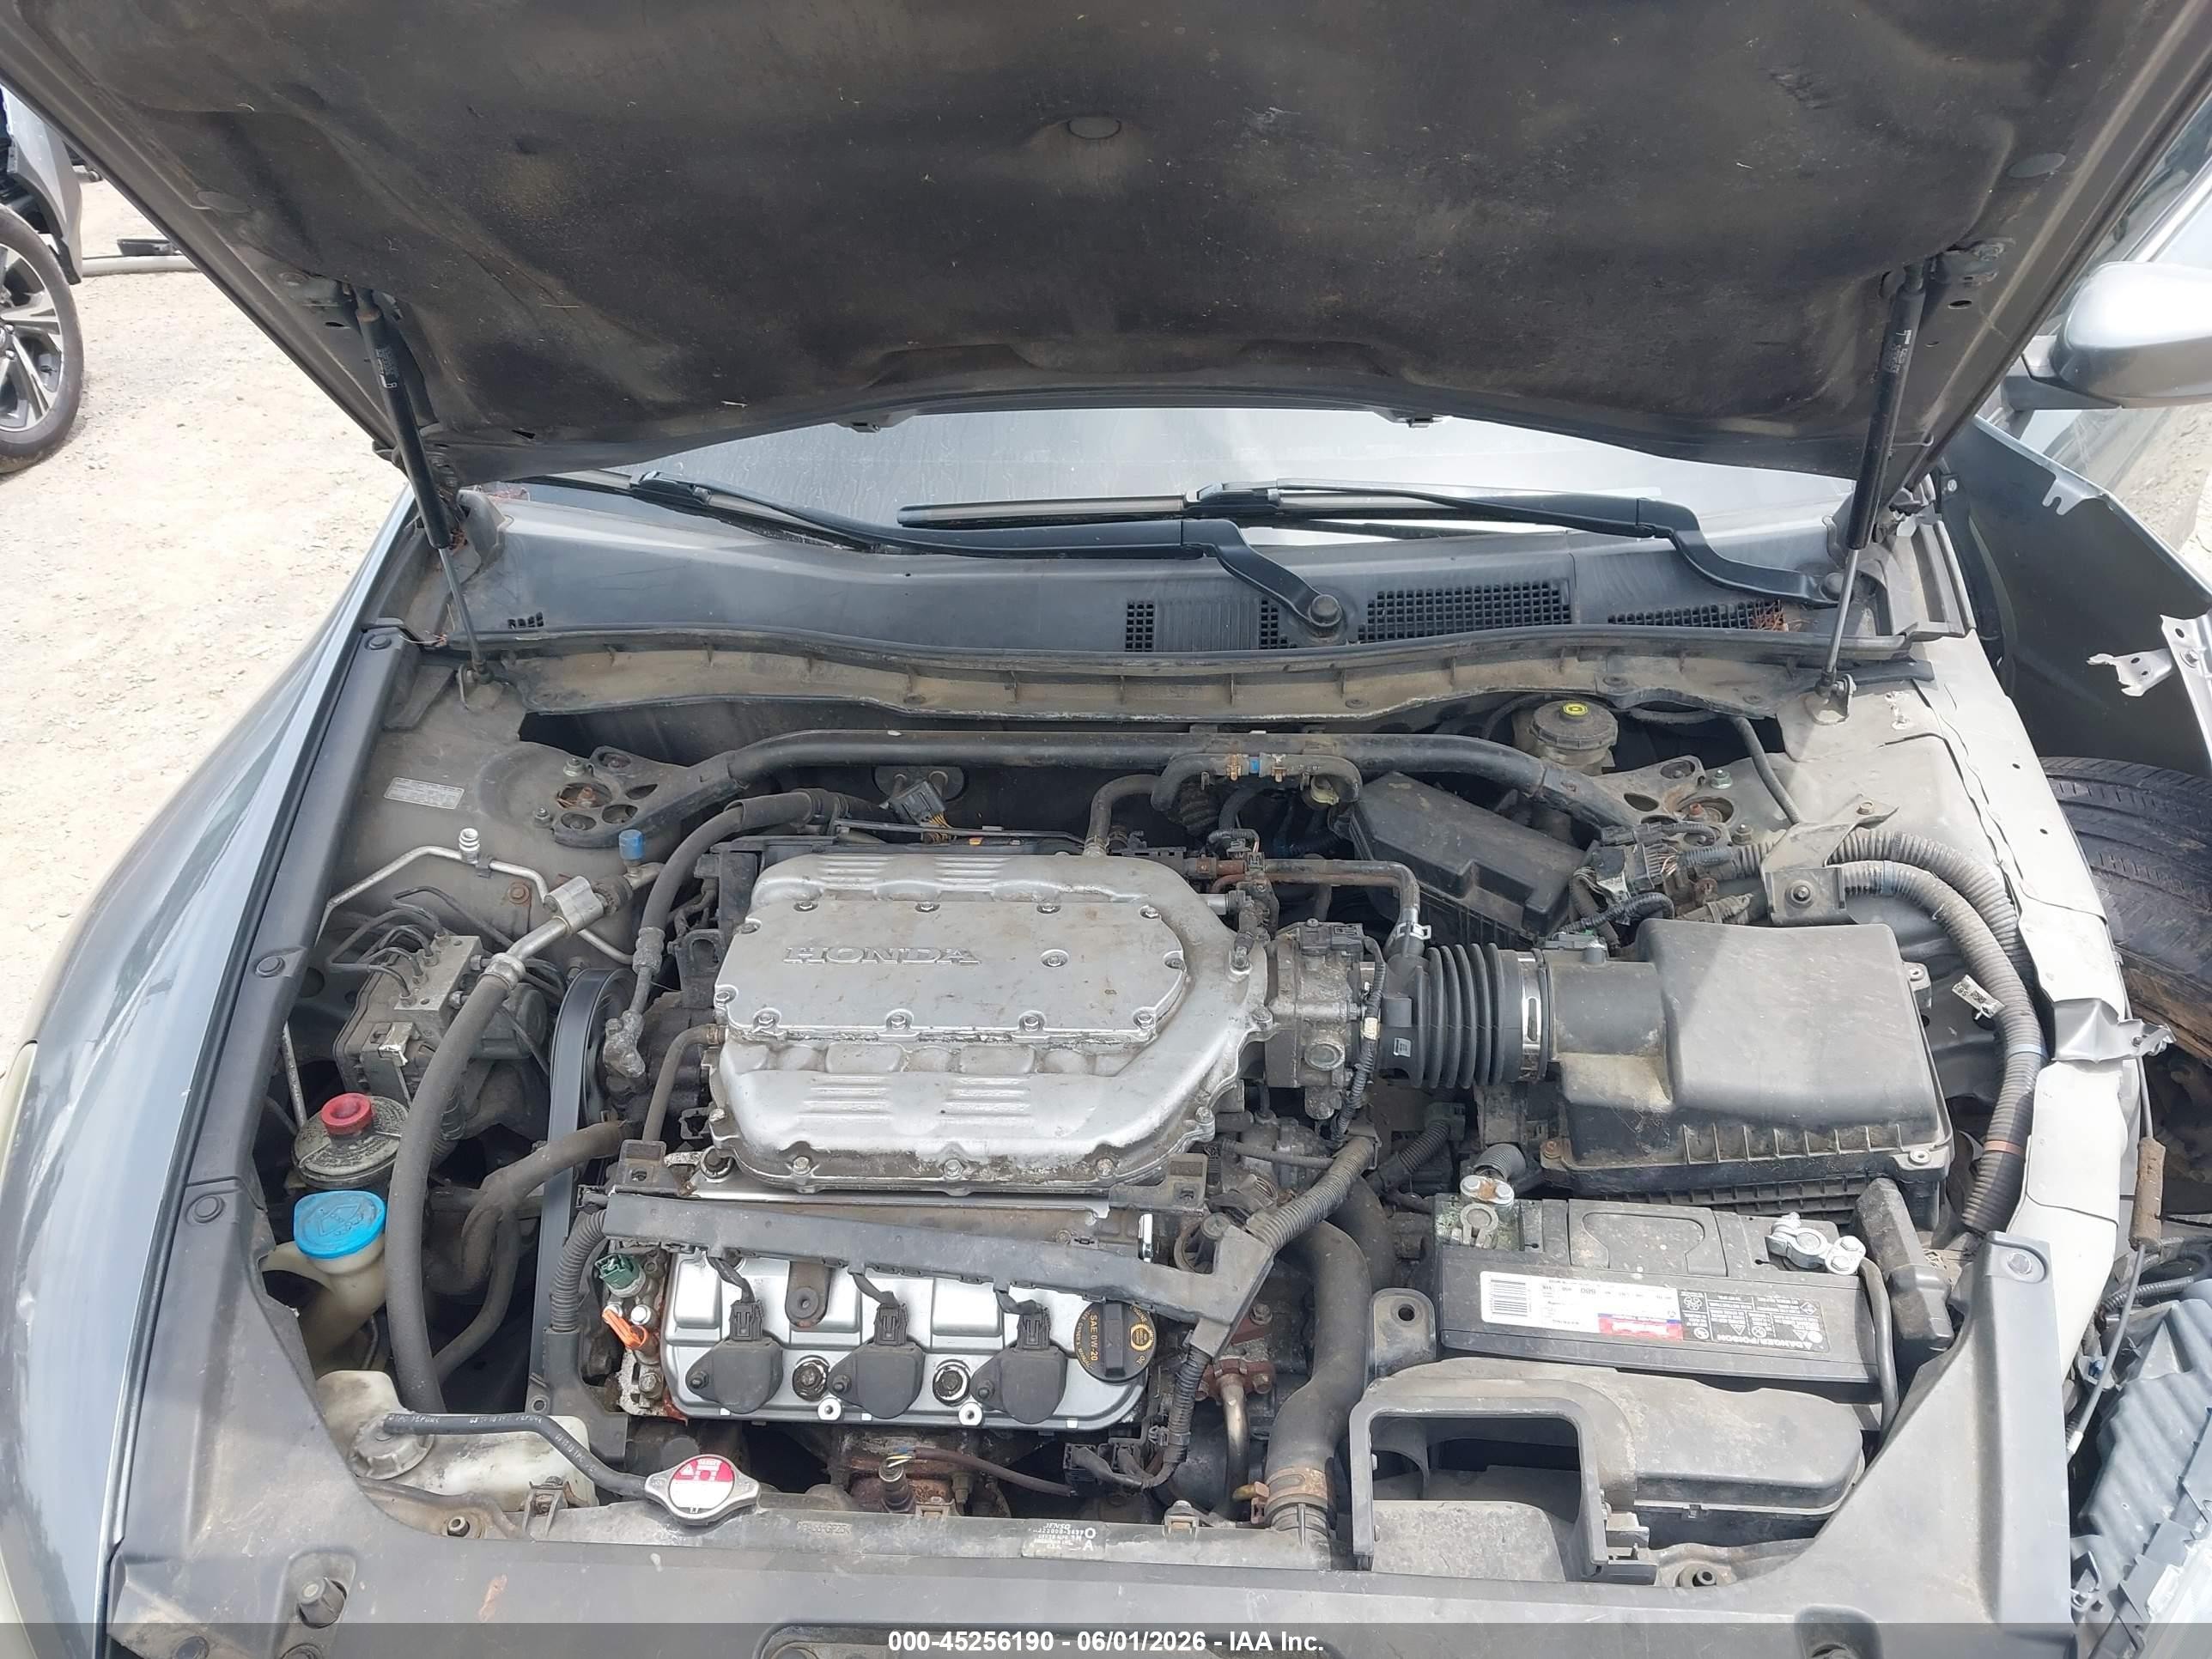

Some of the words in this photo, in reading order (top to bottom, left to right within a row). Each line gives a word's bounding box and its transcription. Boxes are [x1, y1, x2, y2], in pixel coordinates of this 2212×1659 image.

[782, 947, 981, 964] HONDA
[1090, 1314, 1098, 1333] SAE
[1091, 1334, 1099, 1361] 0W-20
[1135, 1355, 1146, 1365] OIL
